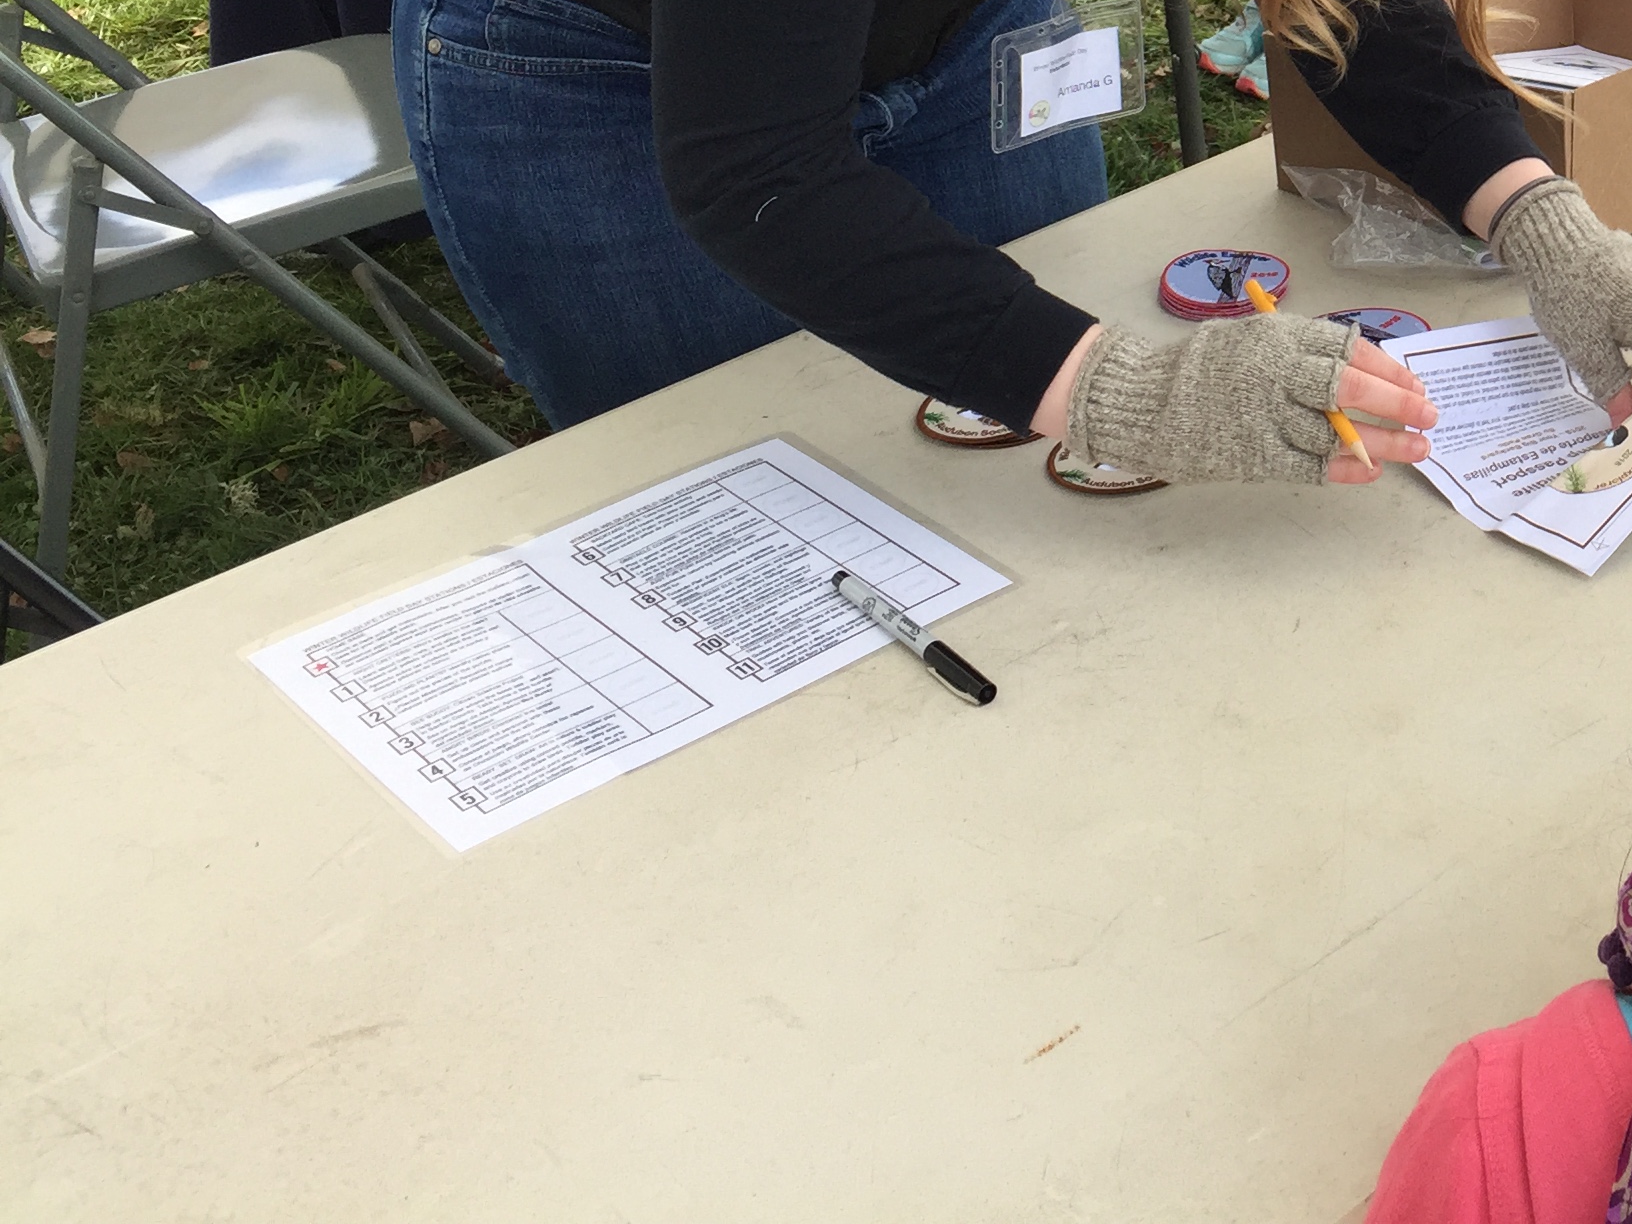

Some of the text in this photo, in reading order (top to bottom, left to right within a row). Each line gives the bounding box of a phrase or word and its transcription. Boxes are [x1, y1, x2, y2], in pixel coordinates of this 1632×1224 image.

[1057, 74, 1113, 97] Amanda G
[1540, 444, 1557, 455] de
[1463, 450, 1540, 482] Estampillas
[1491, 456, 1568, 489] Passport
[1083, 477, 1135, 487] Audubon
[582, 551, 596, 561] 6
[610, 572, 623, 581] 7
[642, 594, 656, 604] 8
[672, 617, 687, 627] 9
[701, 638, 722, 651] 10
[735, 662, 755, 675] 11
[342, 686, 353, 695] 1
[369, 711, 384, 722] 2
[399, 737, 414, 749] 3
[432, 765, 443, 775] 4
[460, 793, 476, 805] 5
